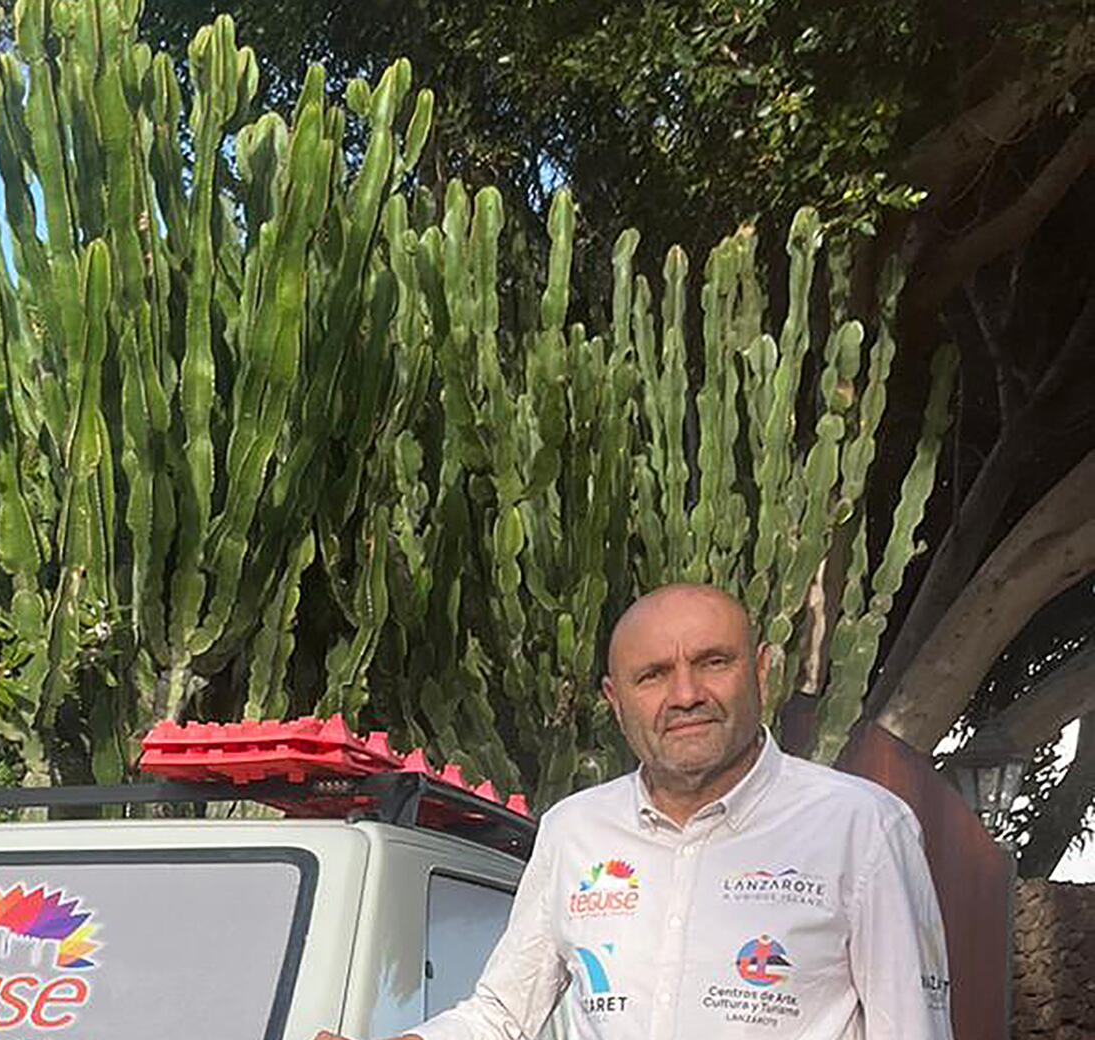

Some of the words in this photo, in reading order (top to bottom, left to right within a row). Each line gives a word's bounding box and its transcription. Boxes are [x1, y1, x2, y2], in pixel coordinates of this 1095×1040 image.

[723, 878, 826, 897] LANZAROTE
[708, 985, 758, 1000] Centros
[759, 990, 776, 1002] de
[703, 996, 750, 1011] Cultura
[761, 1002, 801, 1018] Turismo
